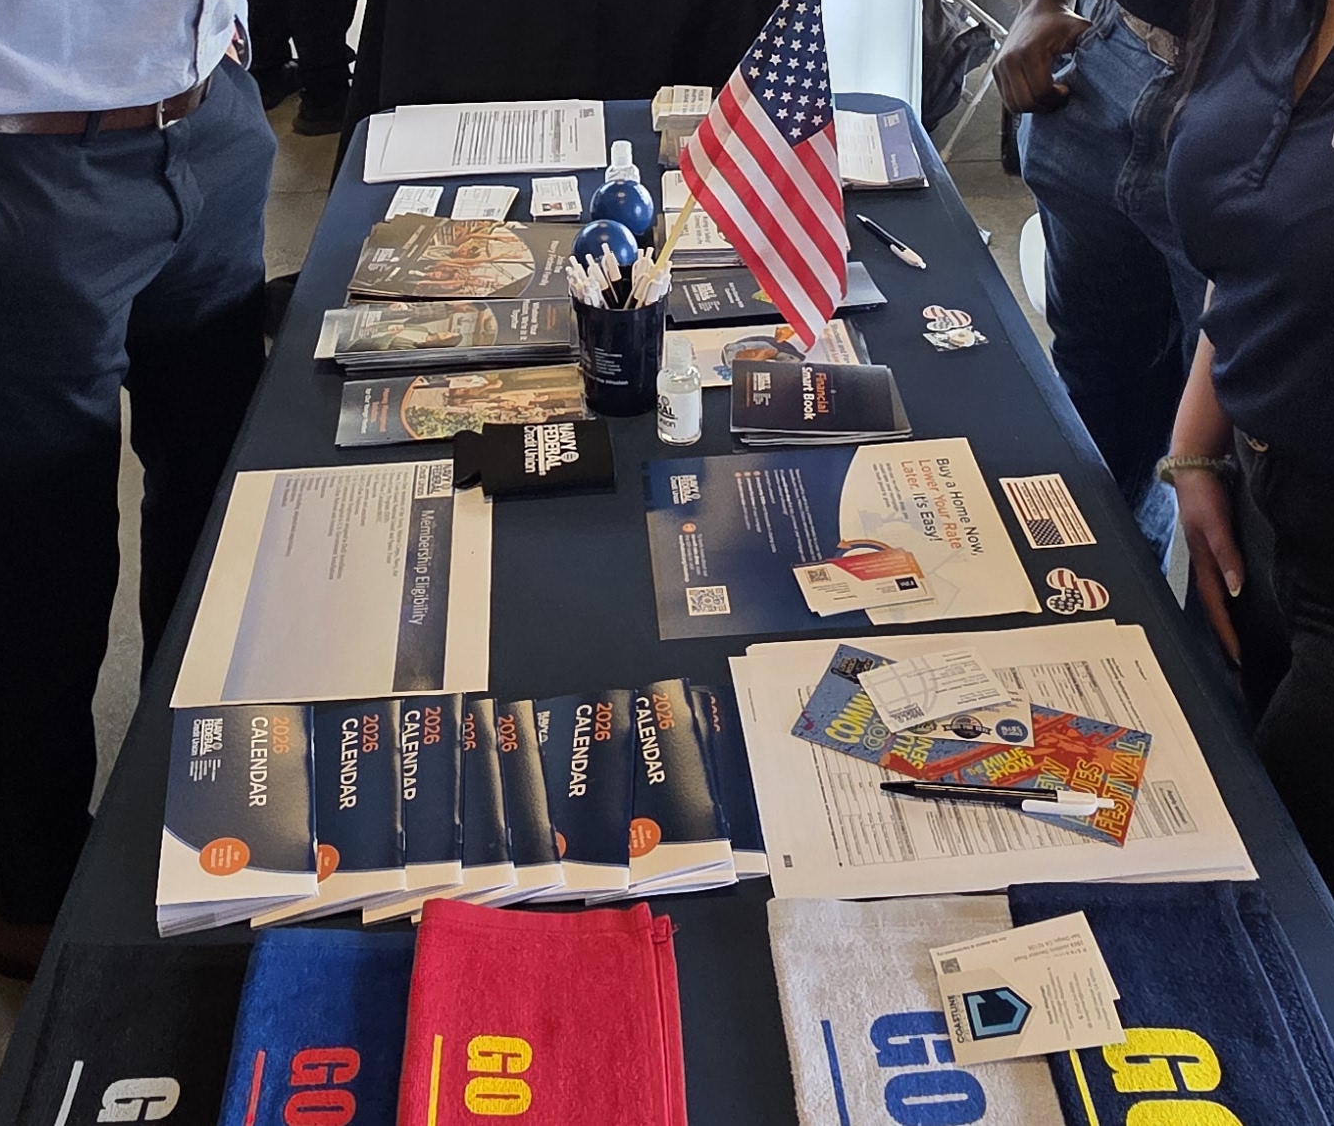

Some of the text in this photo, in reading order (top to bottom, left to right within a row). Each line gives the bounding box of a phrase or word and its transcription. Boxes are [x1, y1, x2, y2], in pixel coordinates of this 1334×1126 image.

[801, 366, 817, 420] Smart Book
[815, 371, 829, 414] Financial
[523, 425, 538, 474] Credit Union
[543, 423, 563, 472] FEDERAL
[558, 422, 578, 451] NAVY
[900, 459, 944, 542] Later. It's Easy!
[918, 459, 962, 550] Lower Your Rate
[936, 457, 953, 479] Buy
[949, 490, 971, 524] Home
[964, 525, 985, 557] Now,
[408, 509, 436, 626] Membership Eligibility
[213, 717, 224, 742] NAVY
[271, 716, 290, 755] 2026
[361, 713, 380, 754] 2026
[422, 706, 442, 745] 2026
[497, 713, 519, 753] 2026
[593, 702, 614, 742] 2026
[651, 692, 675, 730] 2026
[190, 719, 202, 757] Credit Union
[203, 718, 215, 755] FEDERAL
[401, 709, 422, 801] CALENDAR
[568, 703, 593, 798] CALENDAR
[635, 696, 666, 785] CALENDAR
[981, 746, 1028, 773] MILLIE
[248, 715, 269, 808] CALENDAR
[338, 717, 359, 810] CALENDAR
[966, 763, 985, 777] THE
[986, 755, 1035, 782] SHOW
[1092, 740, 1146, 838] FESTIVAL
[946, 994, 966, 1045] COASTLINE
[283, 1046, 362, 1126] GO
[463, 1034, 535, 1116] GO
[869, 1010, 987, 1126] GO
